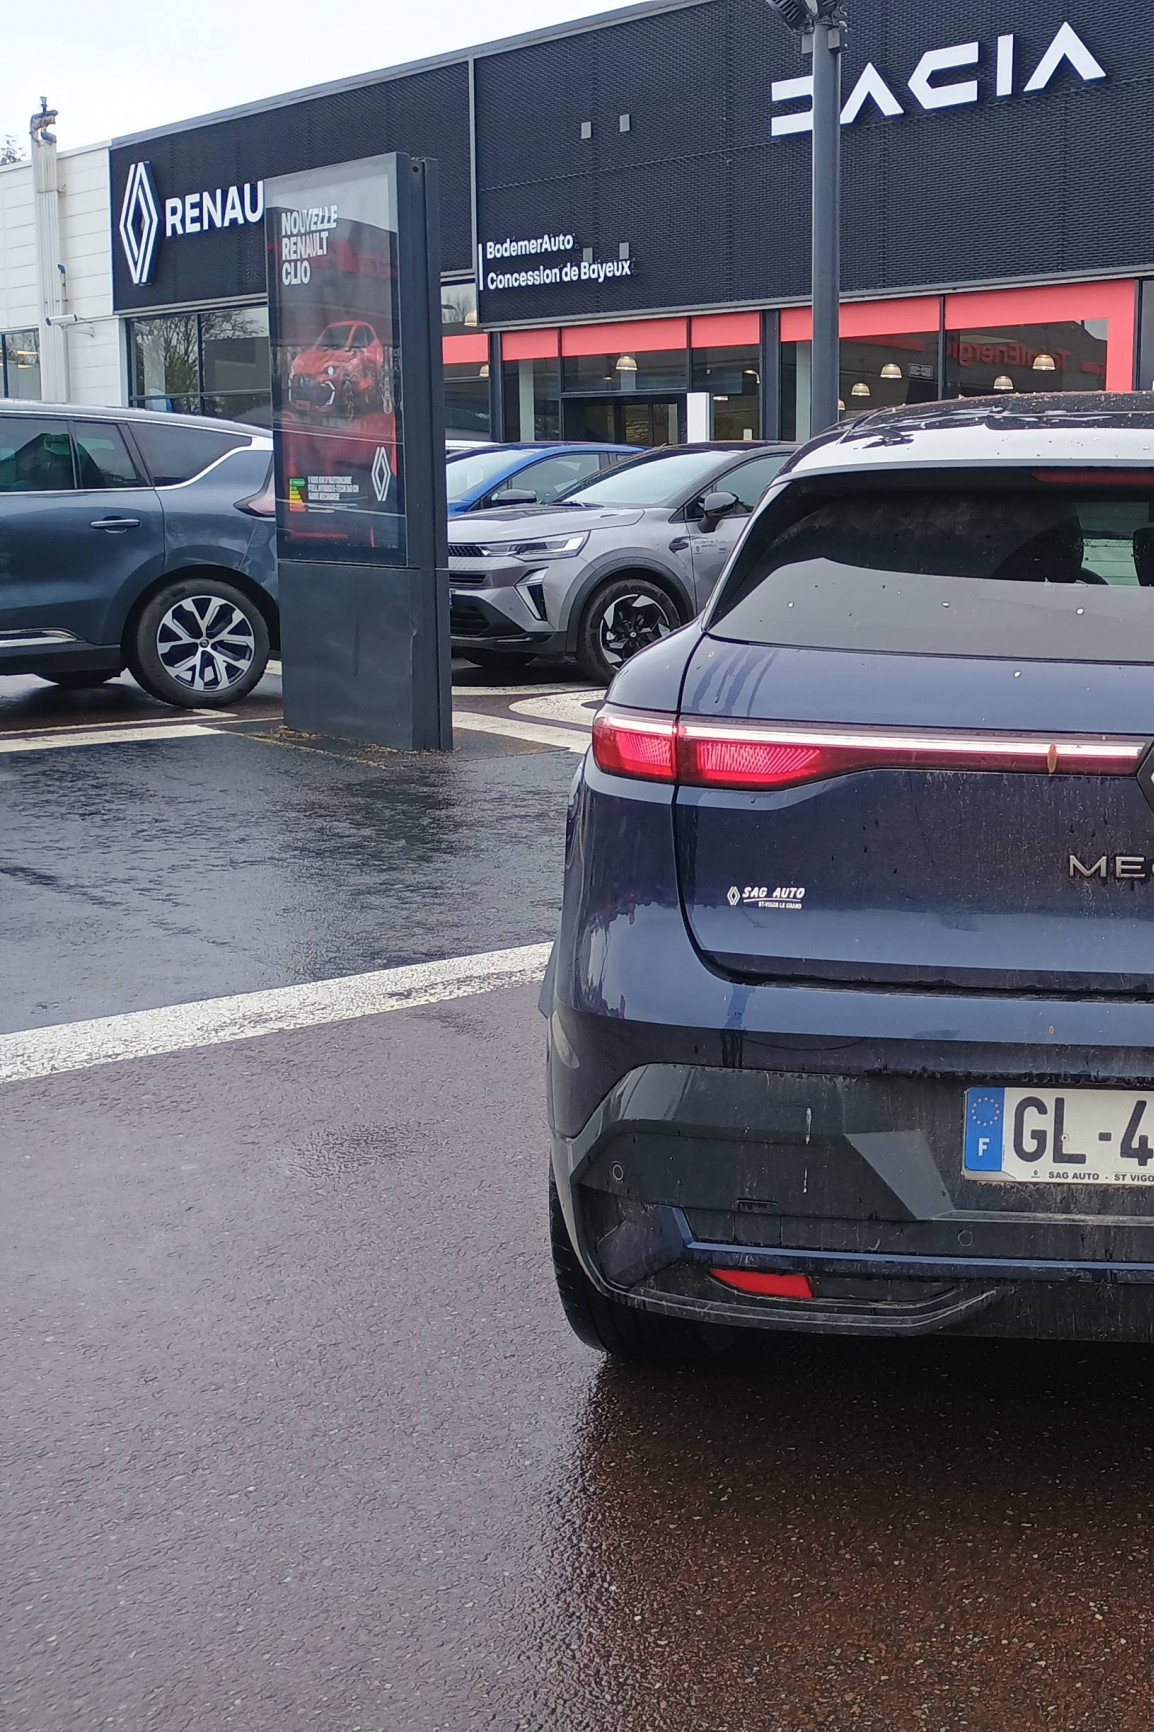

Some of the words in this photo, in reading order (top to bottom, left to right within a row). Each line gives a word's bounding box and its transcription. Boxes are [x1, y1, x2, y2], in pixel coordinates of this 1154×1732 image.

[771, 21, 1106, 136] DACIA
[165, 180, 264, 237] RENAU
[281, 205, 338, 235] NOUVELLE
[281, 231, 329, 260] RENAULT
[486, 233, 574, 259] BodemerAuto
[282, 260, 311, 286] CLIO
[487, 265, 560, 290] Concession
[562, 262, 579, 282] de
[580, 260, 631, 282] Bayeux
[742, 886, 768, 898] SAG
[772, 887, 805, 899] AUTO
[978, 1138, 990, 1156] F
[1048, 1171, 1069, 1180] SAG
[1072, 1172, 1100, 1181] AUTO
[1114, 1173, 1127, 1182] ST
